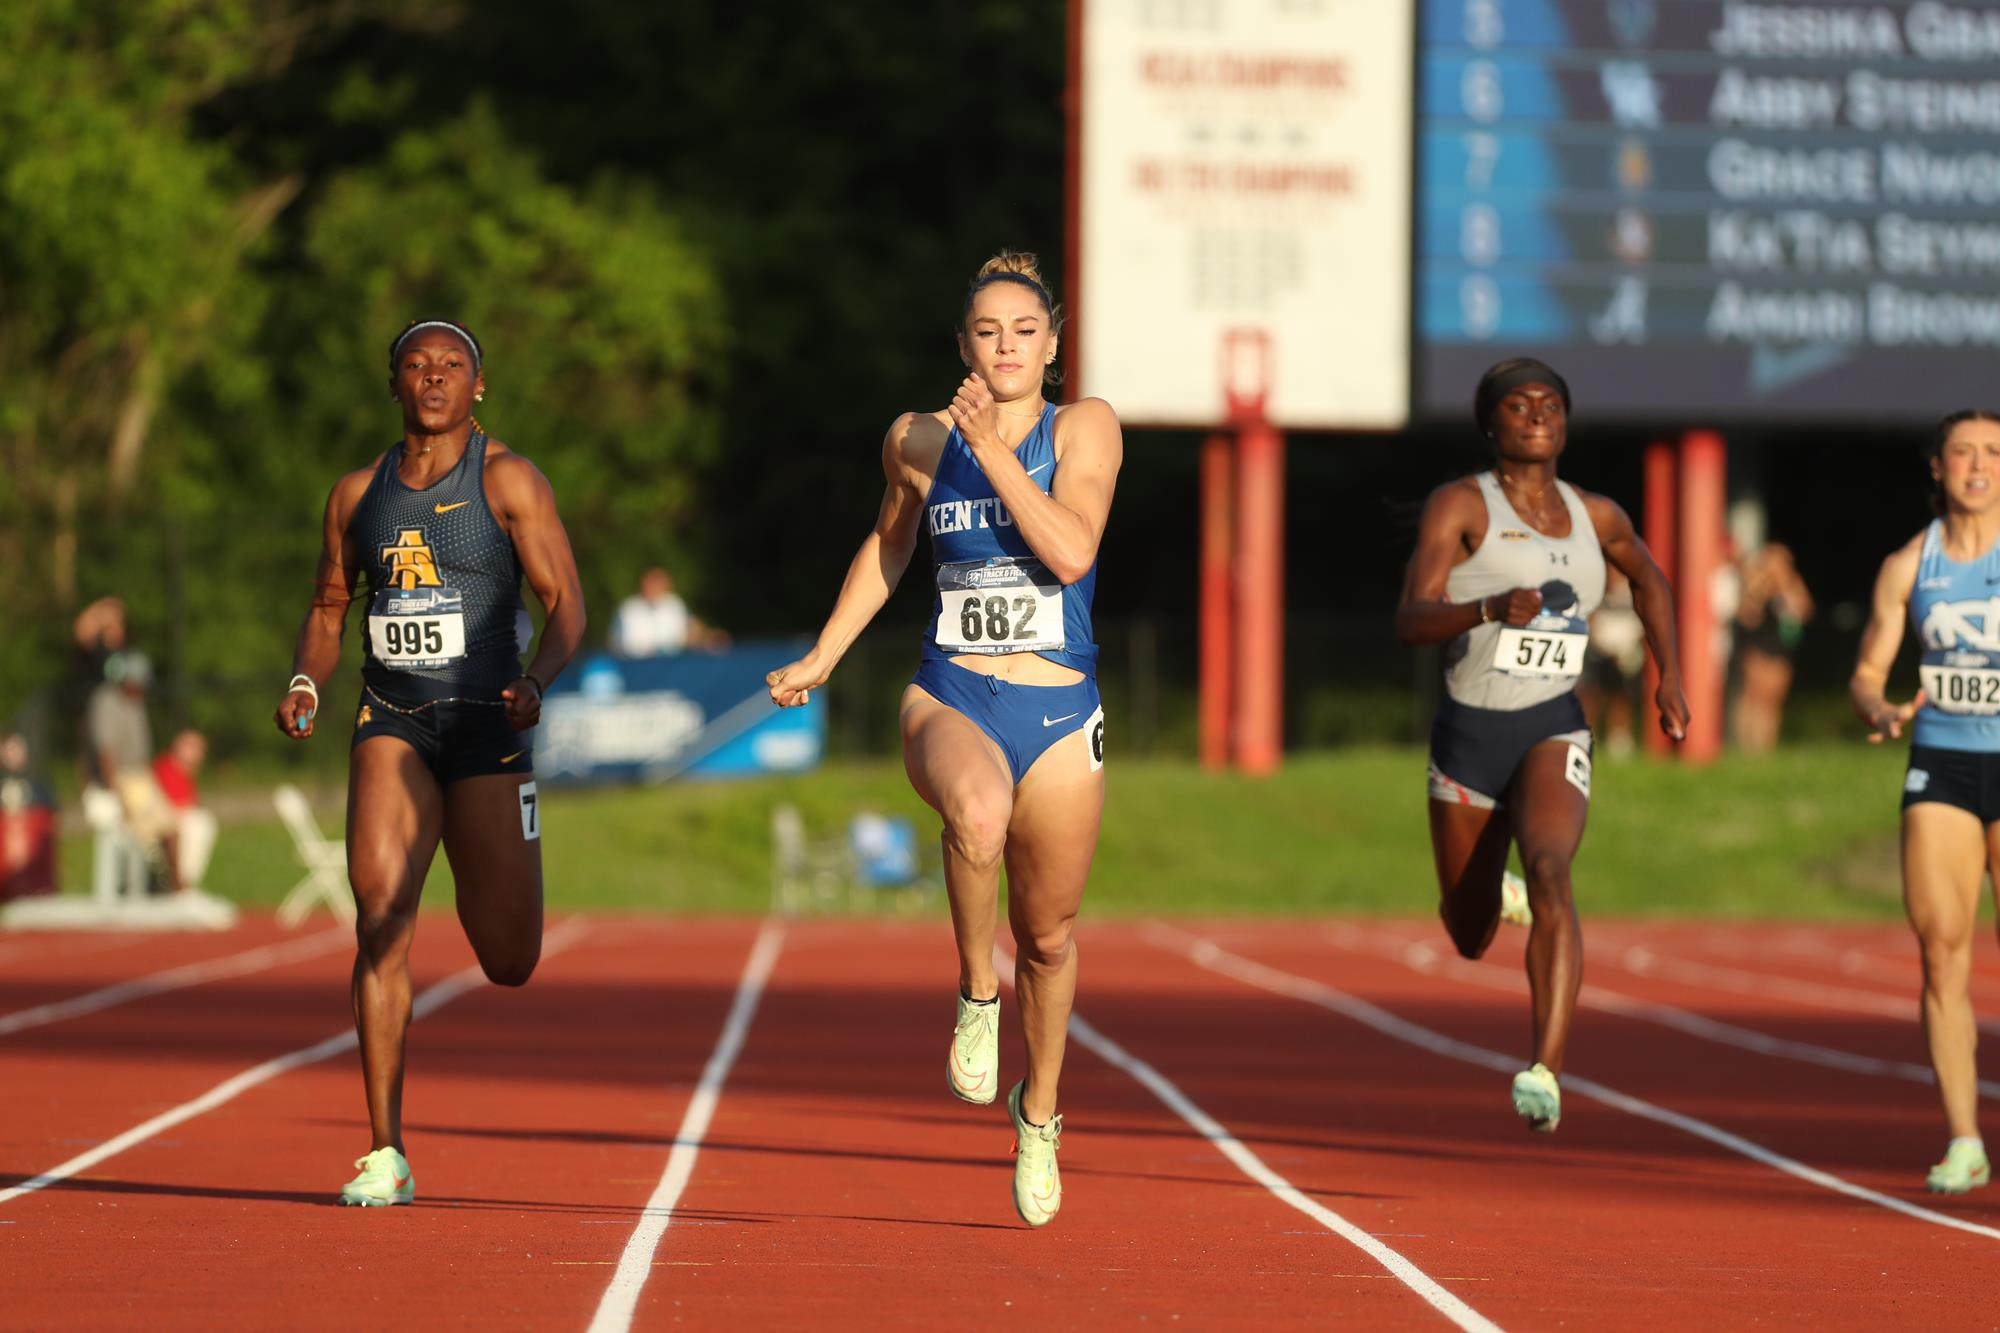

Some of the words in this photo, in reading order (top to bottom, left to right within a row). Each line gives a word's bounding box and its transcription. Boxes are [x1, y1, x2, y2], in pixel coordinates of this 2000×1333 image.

[1463, 132, 1501, 192] 7
[983, 570, 1003, 578] TRACK
[960, 594, 1038, 642] 682
[385, 621, 443, 655] 995
[1517, 637, 1567, 669] 574
[1934, 674, 2000, 704] 1082
[522, 794, 536, 833] 7
